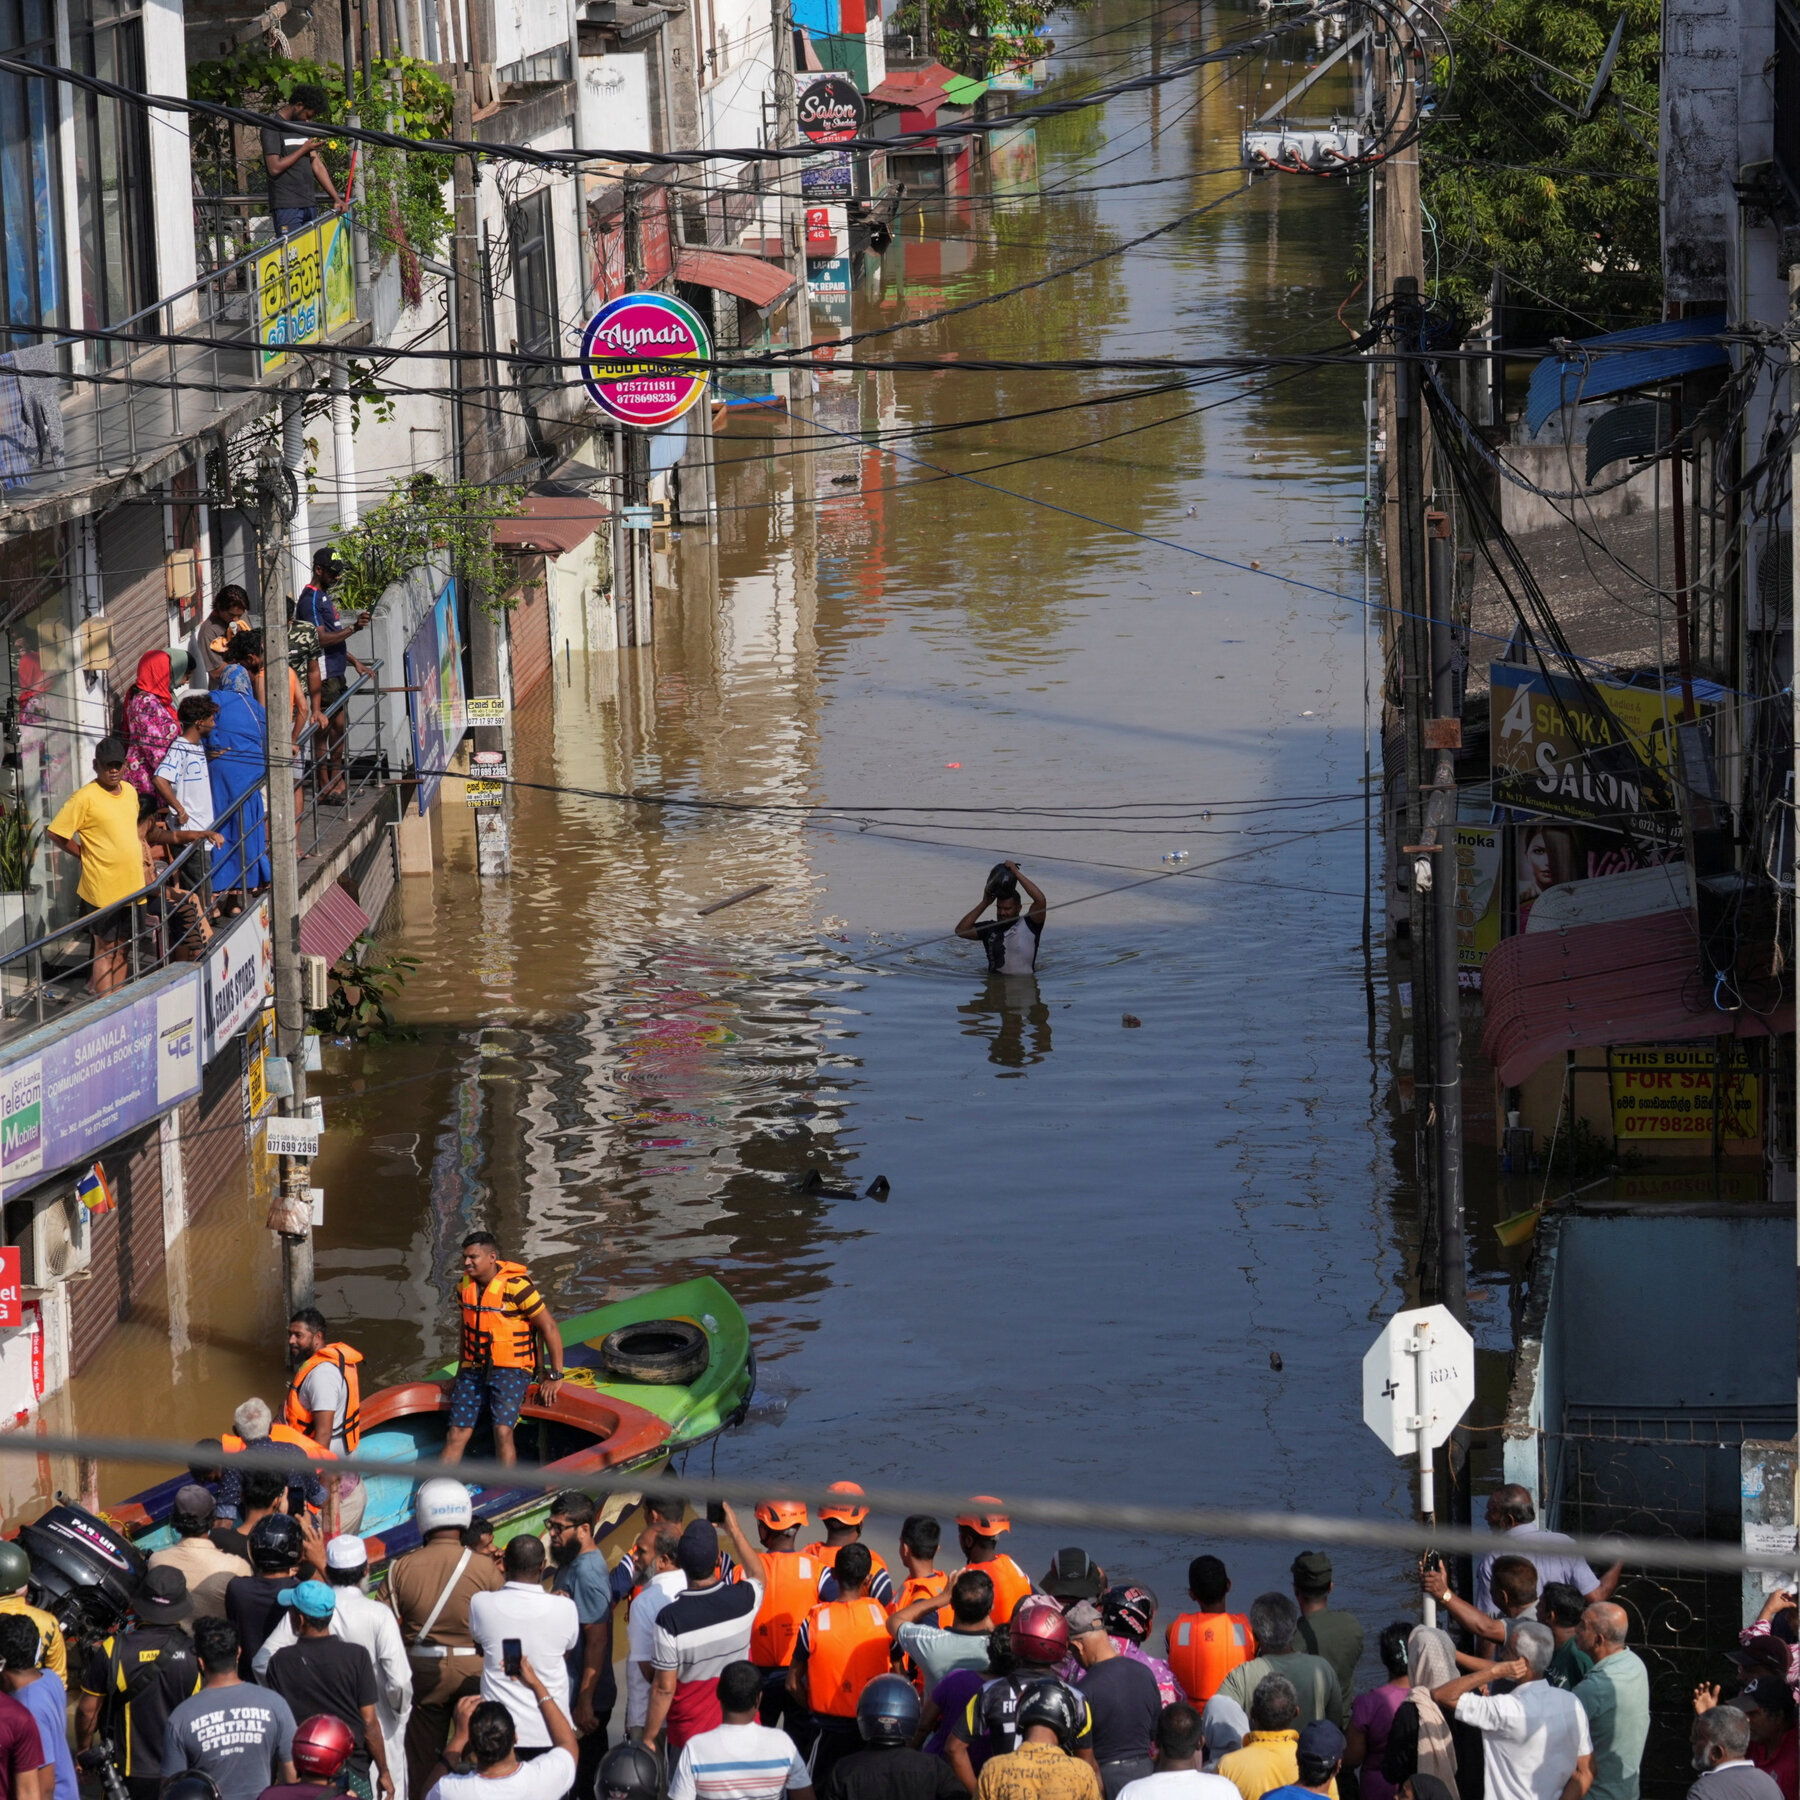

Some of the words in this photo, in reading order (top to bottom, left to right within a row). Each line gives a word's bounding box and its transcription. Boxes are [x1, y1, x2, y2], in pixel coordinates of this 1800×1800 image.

[800, 96, 856, 122] Salon
[813, 260, 840, 270] LAPTOP
[820, 282, 846, 291] REPAIR
[824, 272, 831, 281] &
[599, 323, 688, 354] Ayman
[616, 381, 676, 391] 0757711811
[617, 393, 677, 403] 0778698236
[1535, 742, 1639, 812] SALON
[1456, 832, 1495, 848] hoka
[1458, 950, 1475, 960] 875
[215, 978, 235, 1028] GRAMS
[235, 954, 255, 1006] STORES
[75, 1025, 126, 1066] SAMANALA
[168, 1034, 190, 1059] 4G
[48, 1057, 106, 1098] COMMUNICATION
[107, 1055, 112, 1067] &
[113, 1043, 133, 1063] BOOK
[134, 1033, 153, 1053] SHOP
[1620, 1053, 1658, 1064] THIS
[14, 1079, 22, 1092] Sri
[23, 1071, 40, 1087] Lanka
[1626, 1072, 1672, 1088] FOR
[1680, 1071, 1739, 1088] SAE
[0, 1084, 40, 1118] Telecom
[4, 1122, 39, 1157] Mobitel
[267, 1141, 280, 1151] 077
[281, 1141, 296, 1152] 699
[297, 1142, 317, 1153] 2396
[1430, 1366, 1458, 1384] RDA
[190, 1710, 226, 1733] NEW
[229, 1707, 271, 1722] YORK
[197, 1719, 266, 1742] CENTRAL
[201, 1732, 263, 1752] STUDIOS
